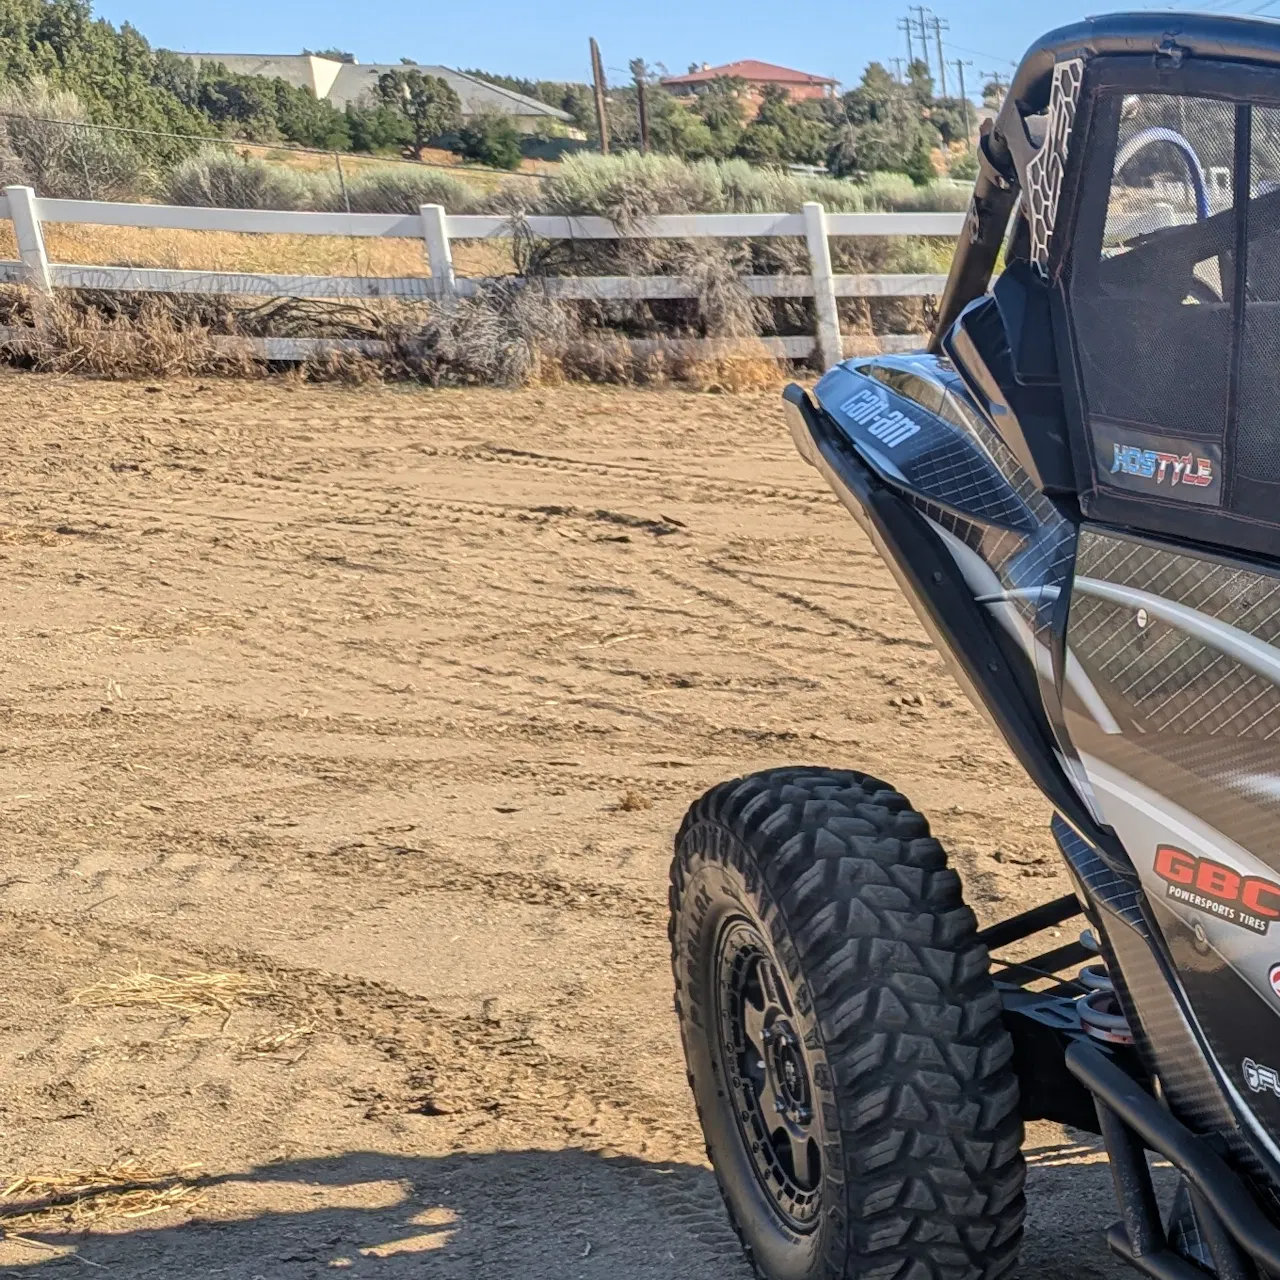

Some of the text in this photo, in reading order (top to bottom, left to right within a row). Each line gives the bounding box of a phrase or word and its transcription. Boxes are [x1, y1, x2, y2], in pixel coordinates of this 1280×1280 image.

[1110, 442, 1213, 488] HOSTYLE
[1168, 885, 1267, 931] POWERSPORTS TIRES
